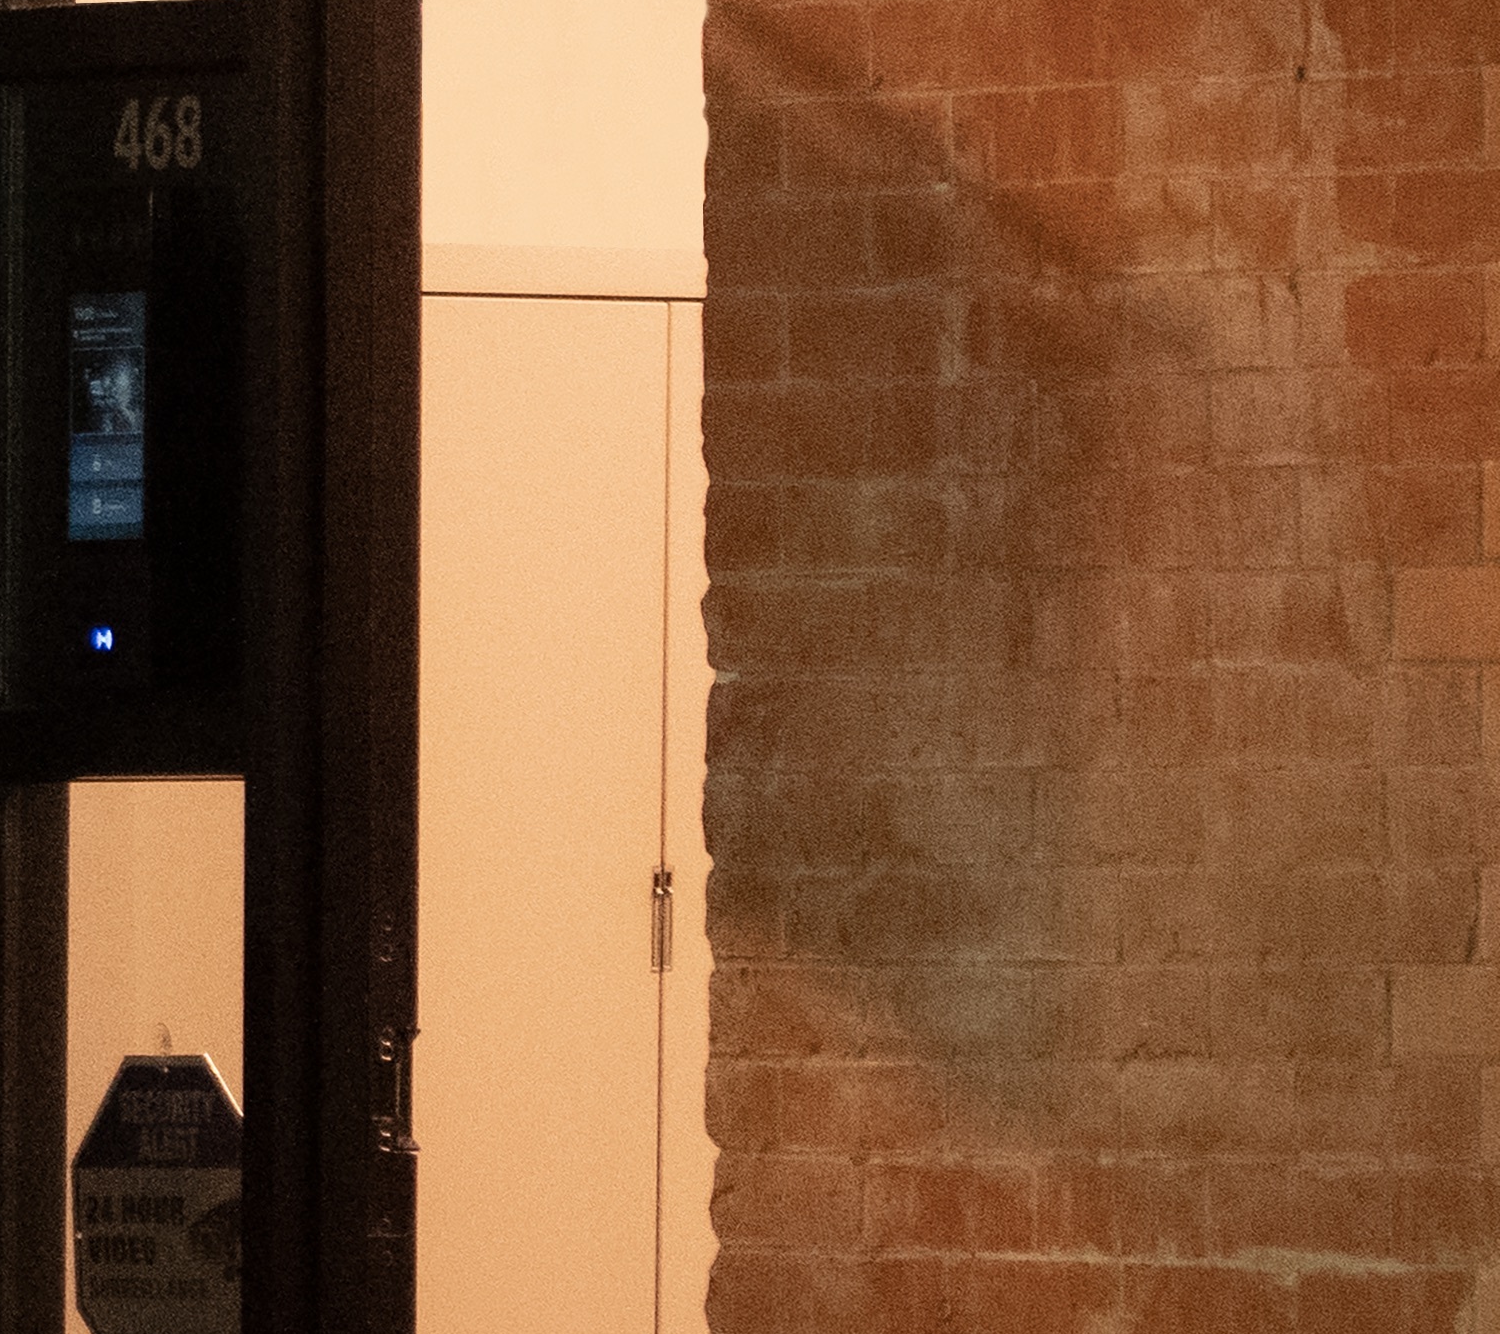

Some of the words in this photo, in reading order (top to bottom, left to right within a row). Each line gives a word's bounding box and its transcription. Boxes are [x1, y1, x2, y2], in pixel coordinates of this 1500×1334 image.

[113, 95, 204, 171] 468
[86, 1195, 114, 1225] 24
[121, 1195, 186, 1226] HOUR
[87, 1234, 157, 1266] VIDEO
